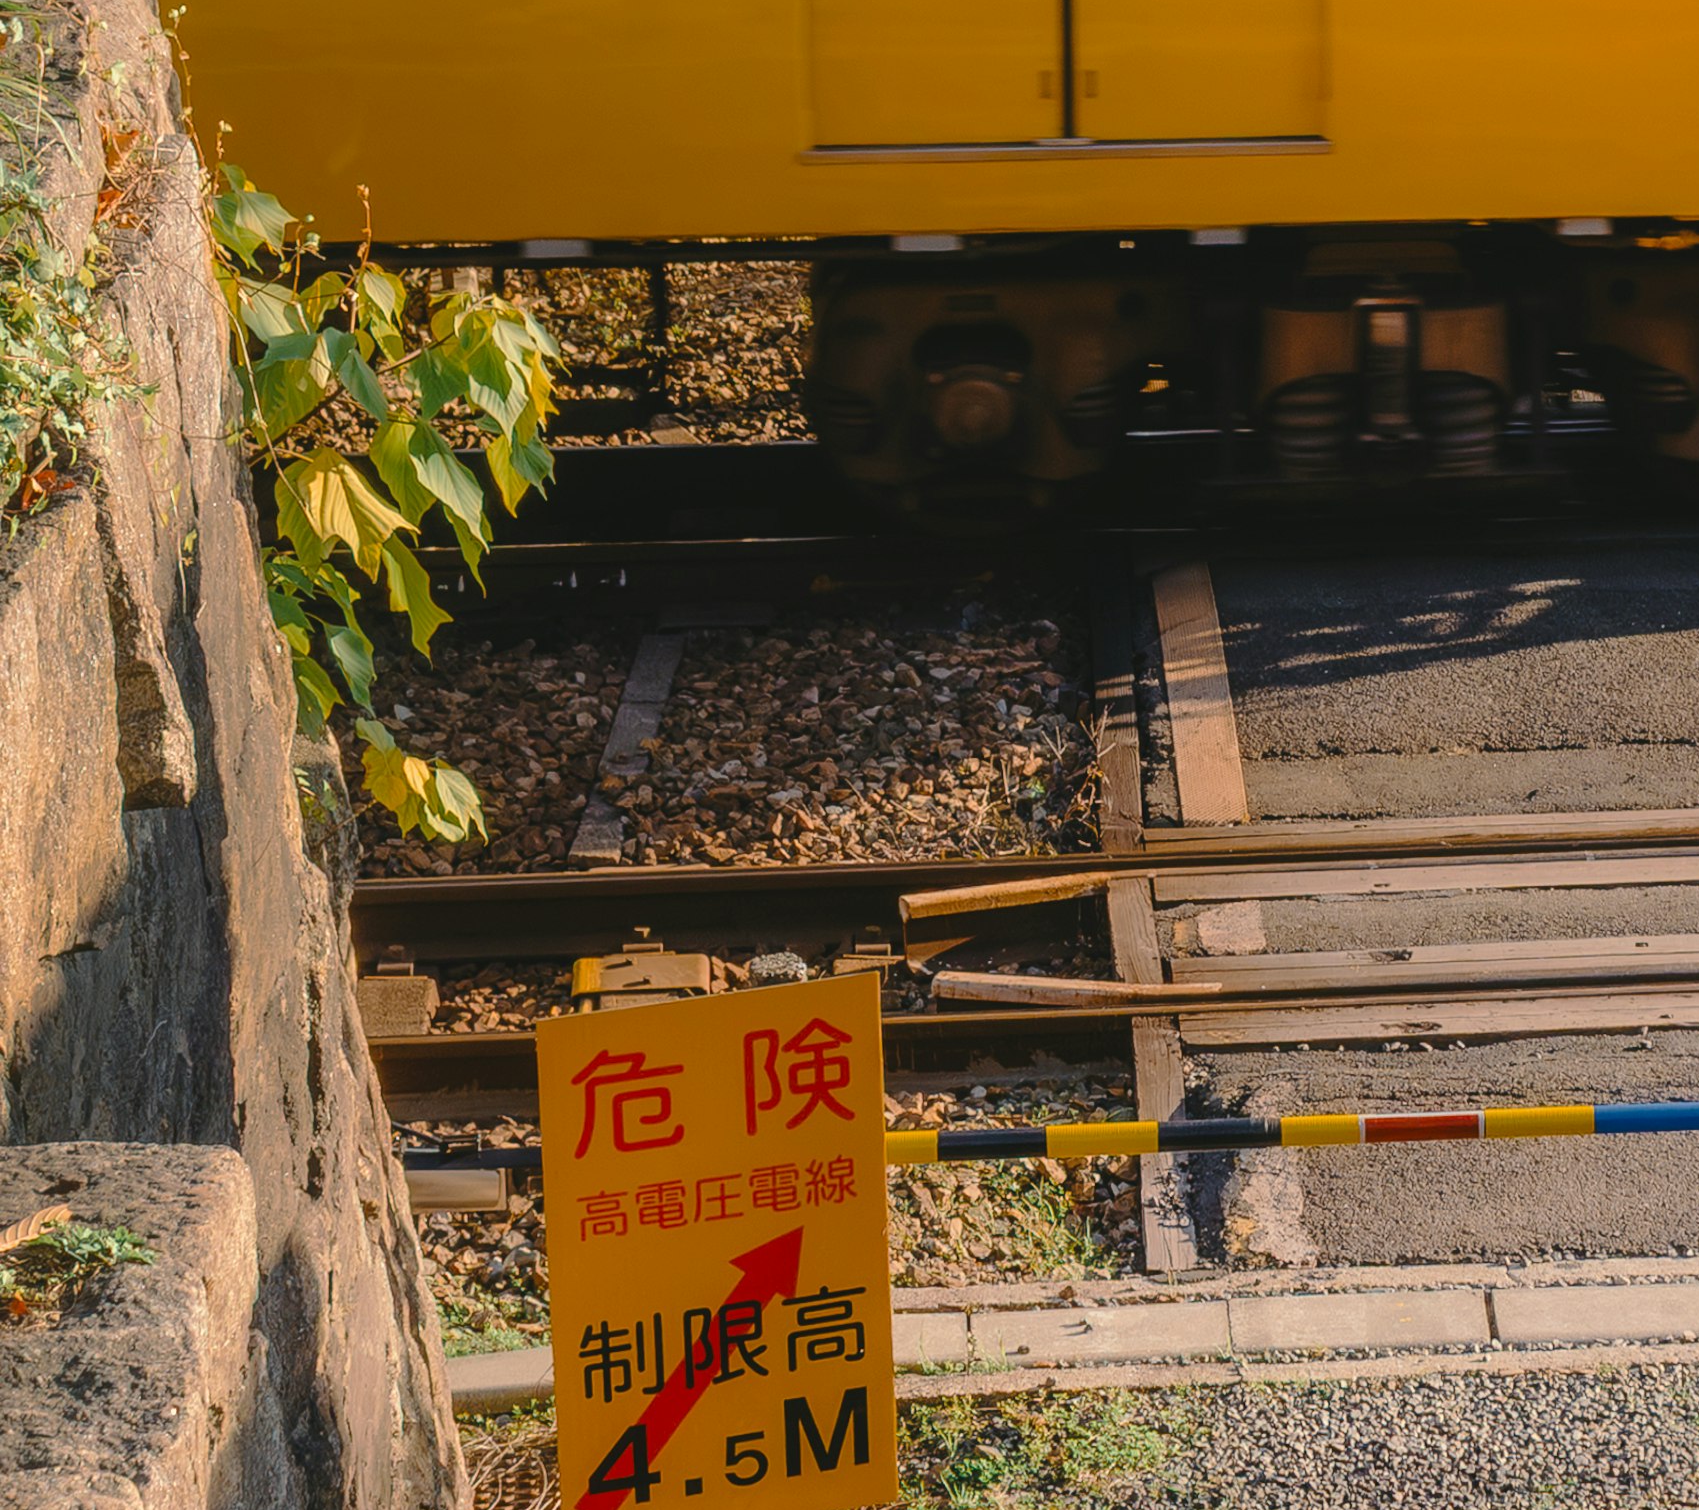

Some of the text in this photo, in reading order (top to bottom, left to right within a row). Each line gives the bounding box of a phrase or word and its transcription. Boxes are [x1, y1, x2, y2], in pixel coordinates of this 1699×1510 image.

[571, 1018, 856, 1159] 危険
[576, 1154, 858, 1242] 高電圧電線
[578, 1286, 867, 1404] 制限高
[588, 1385, 870, 1504] 4.5M
